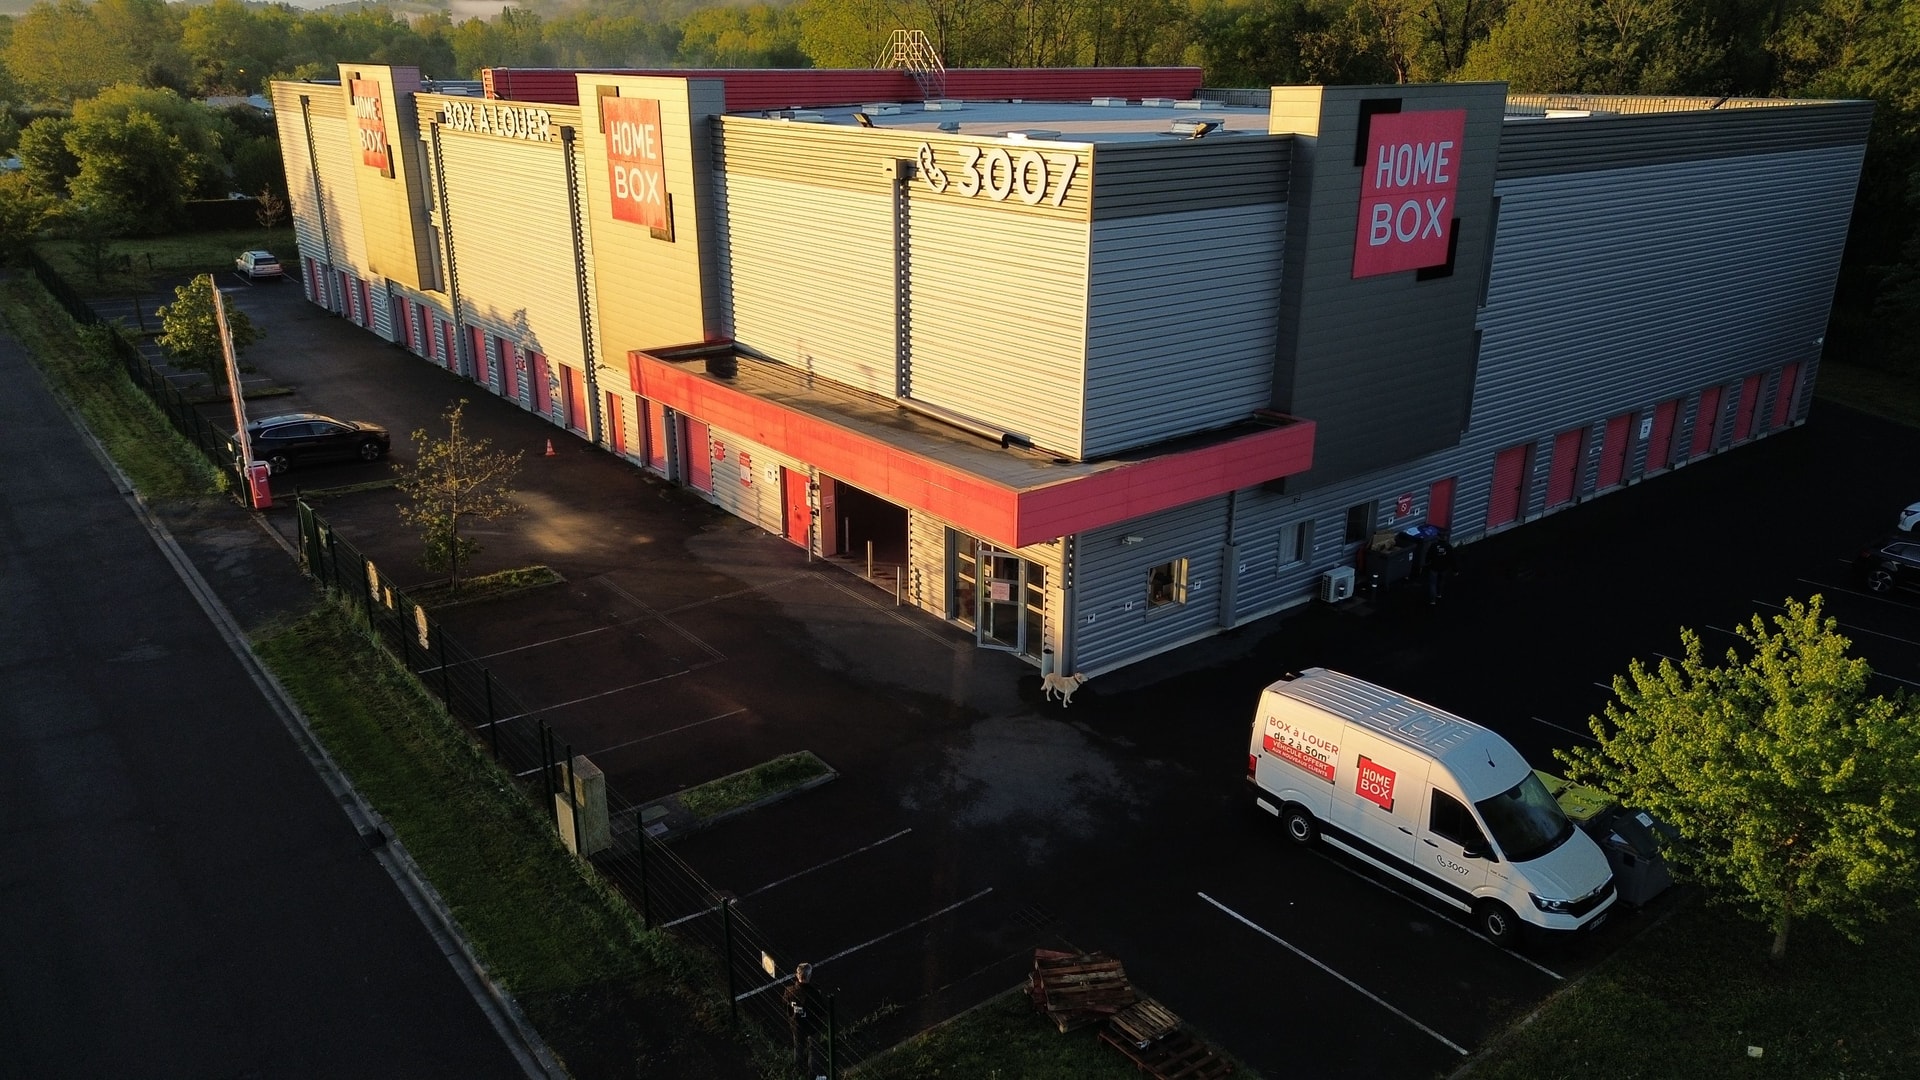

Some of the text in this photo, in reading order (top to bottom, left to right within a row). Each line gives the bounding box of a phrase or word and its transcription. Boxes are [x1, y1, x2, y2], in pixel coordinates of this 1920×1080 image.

[353, 95, 379, 120] HOME
[443, 101, 476, 132] BOX
[493, 105, 552, 142] LOUER
[360, 128, 384, 154] BOX
[610, 120, 657, 160] HOME
[957, 146, 1079, 207] 3007
[1375, 141, 1454, 189] HOME
[614, 165, 660, 206] BOX
[1370, 197, 1447, 246] BOX
[1269, 716, 1291, 733] BOX
[1302, 731, 1339, 755] LOUER
[1274, 732, 1286, 743] de
[1288, 738, 1294, 747] 2
[1303, 753, 1328, 771] OFFERT
[1362, 767, 1392, 789] HOME
[1360, 778, 1390, 800] BOX
[1446, 860, 1470, 876] 3007
